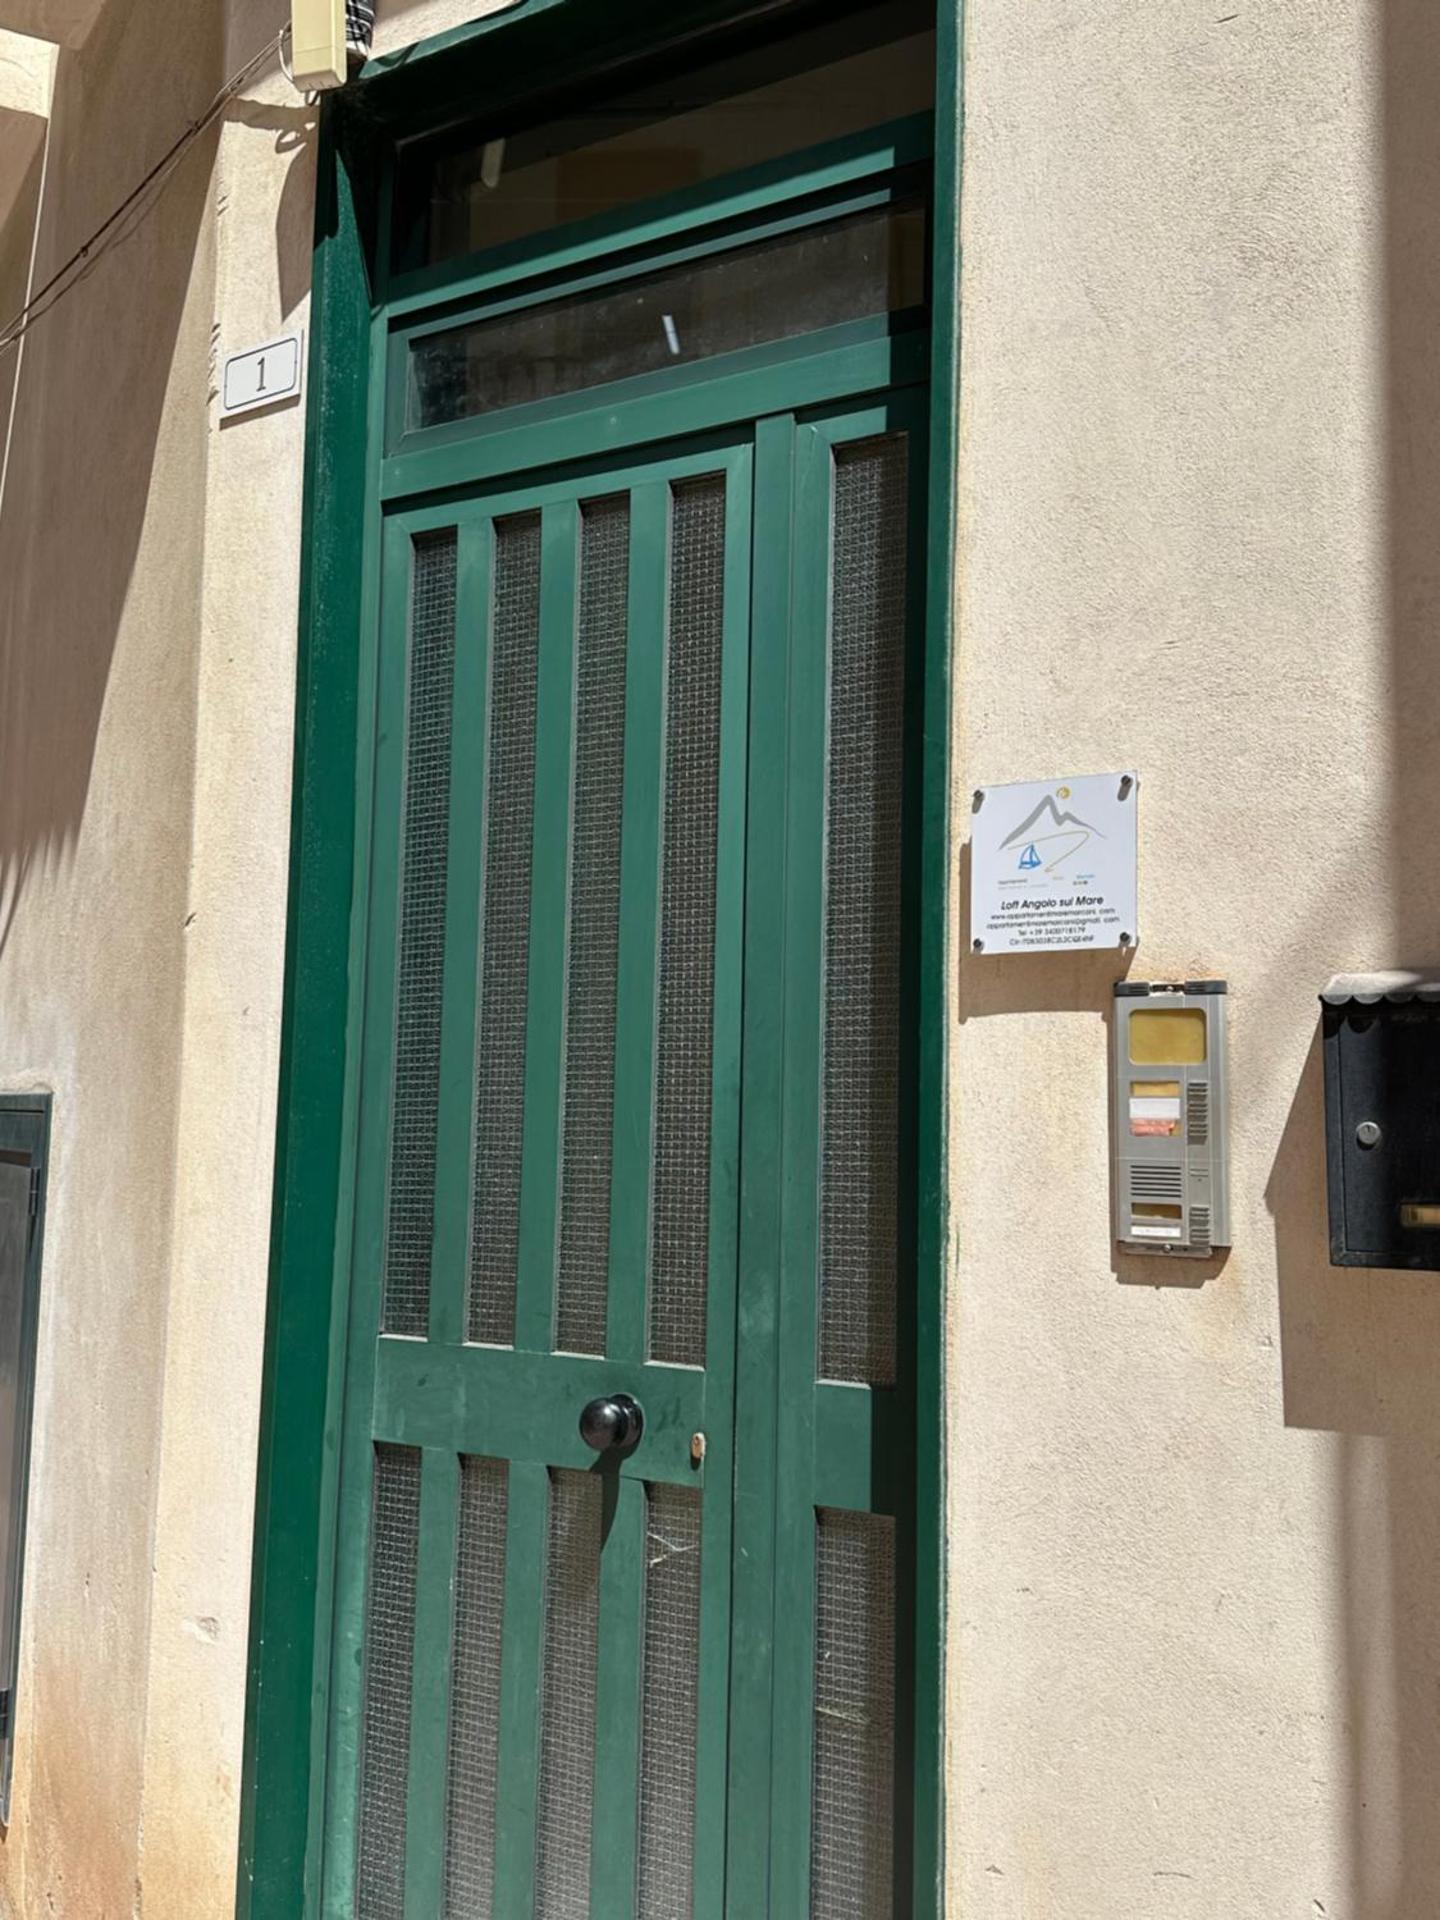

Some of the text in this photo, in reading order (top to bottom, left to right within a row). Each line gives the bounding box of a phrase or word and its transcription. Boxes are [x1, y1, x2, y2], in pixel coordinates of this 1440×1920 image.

[256, 357, 267, 392] 1
[1001, 895, 1104, 911] Loft Angolo sul Mare
